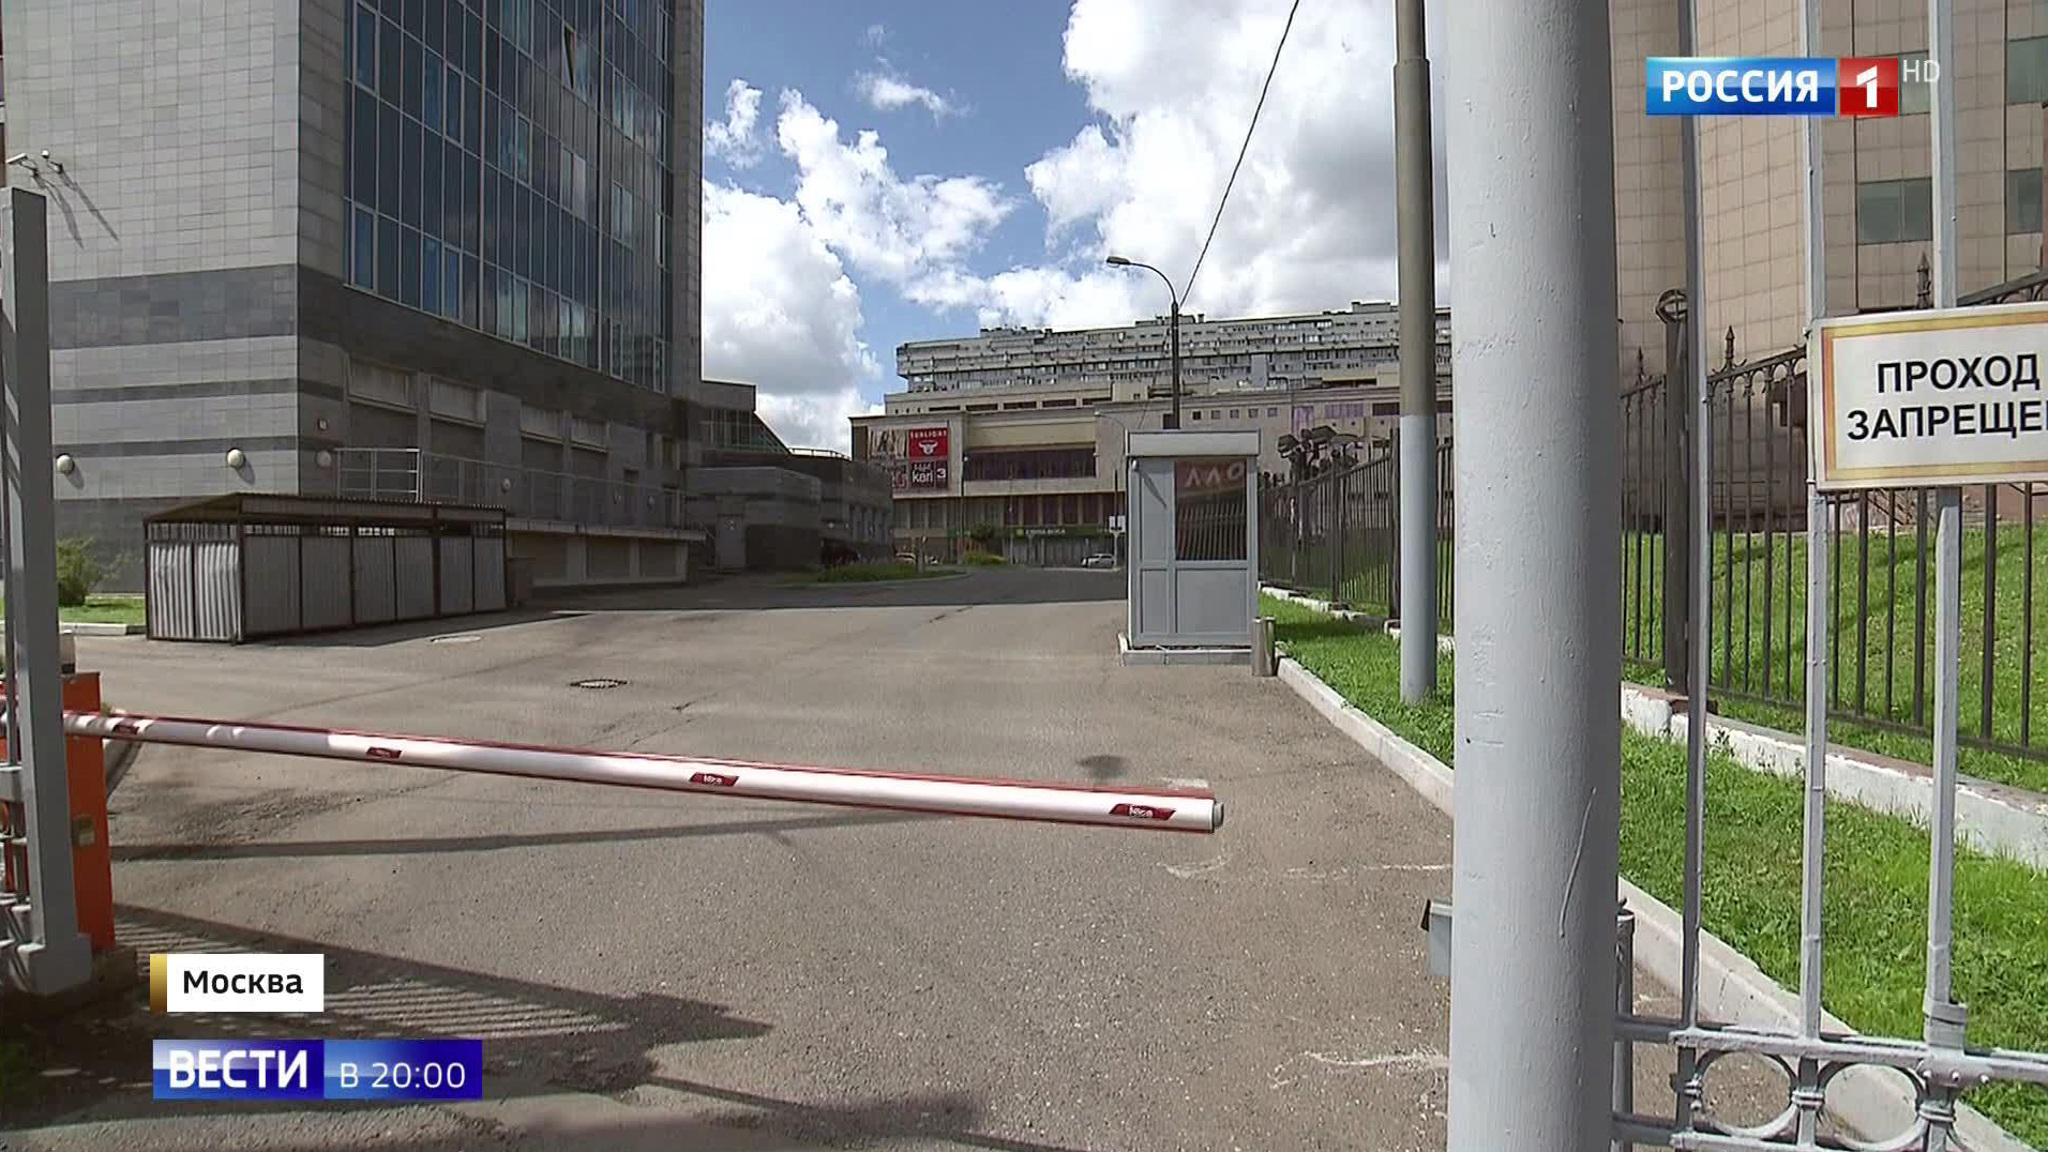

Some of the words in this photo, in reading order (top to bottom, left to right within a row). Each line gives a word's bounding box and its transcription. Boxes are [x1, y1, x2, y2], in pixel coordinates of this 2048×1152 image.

[1877, 353, 2041, 394] ПРОХОД
[1847, 400, 2048, 440] ЗАПРЕЩЕ
[936, 468, 947, 479] 3
